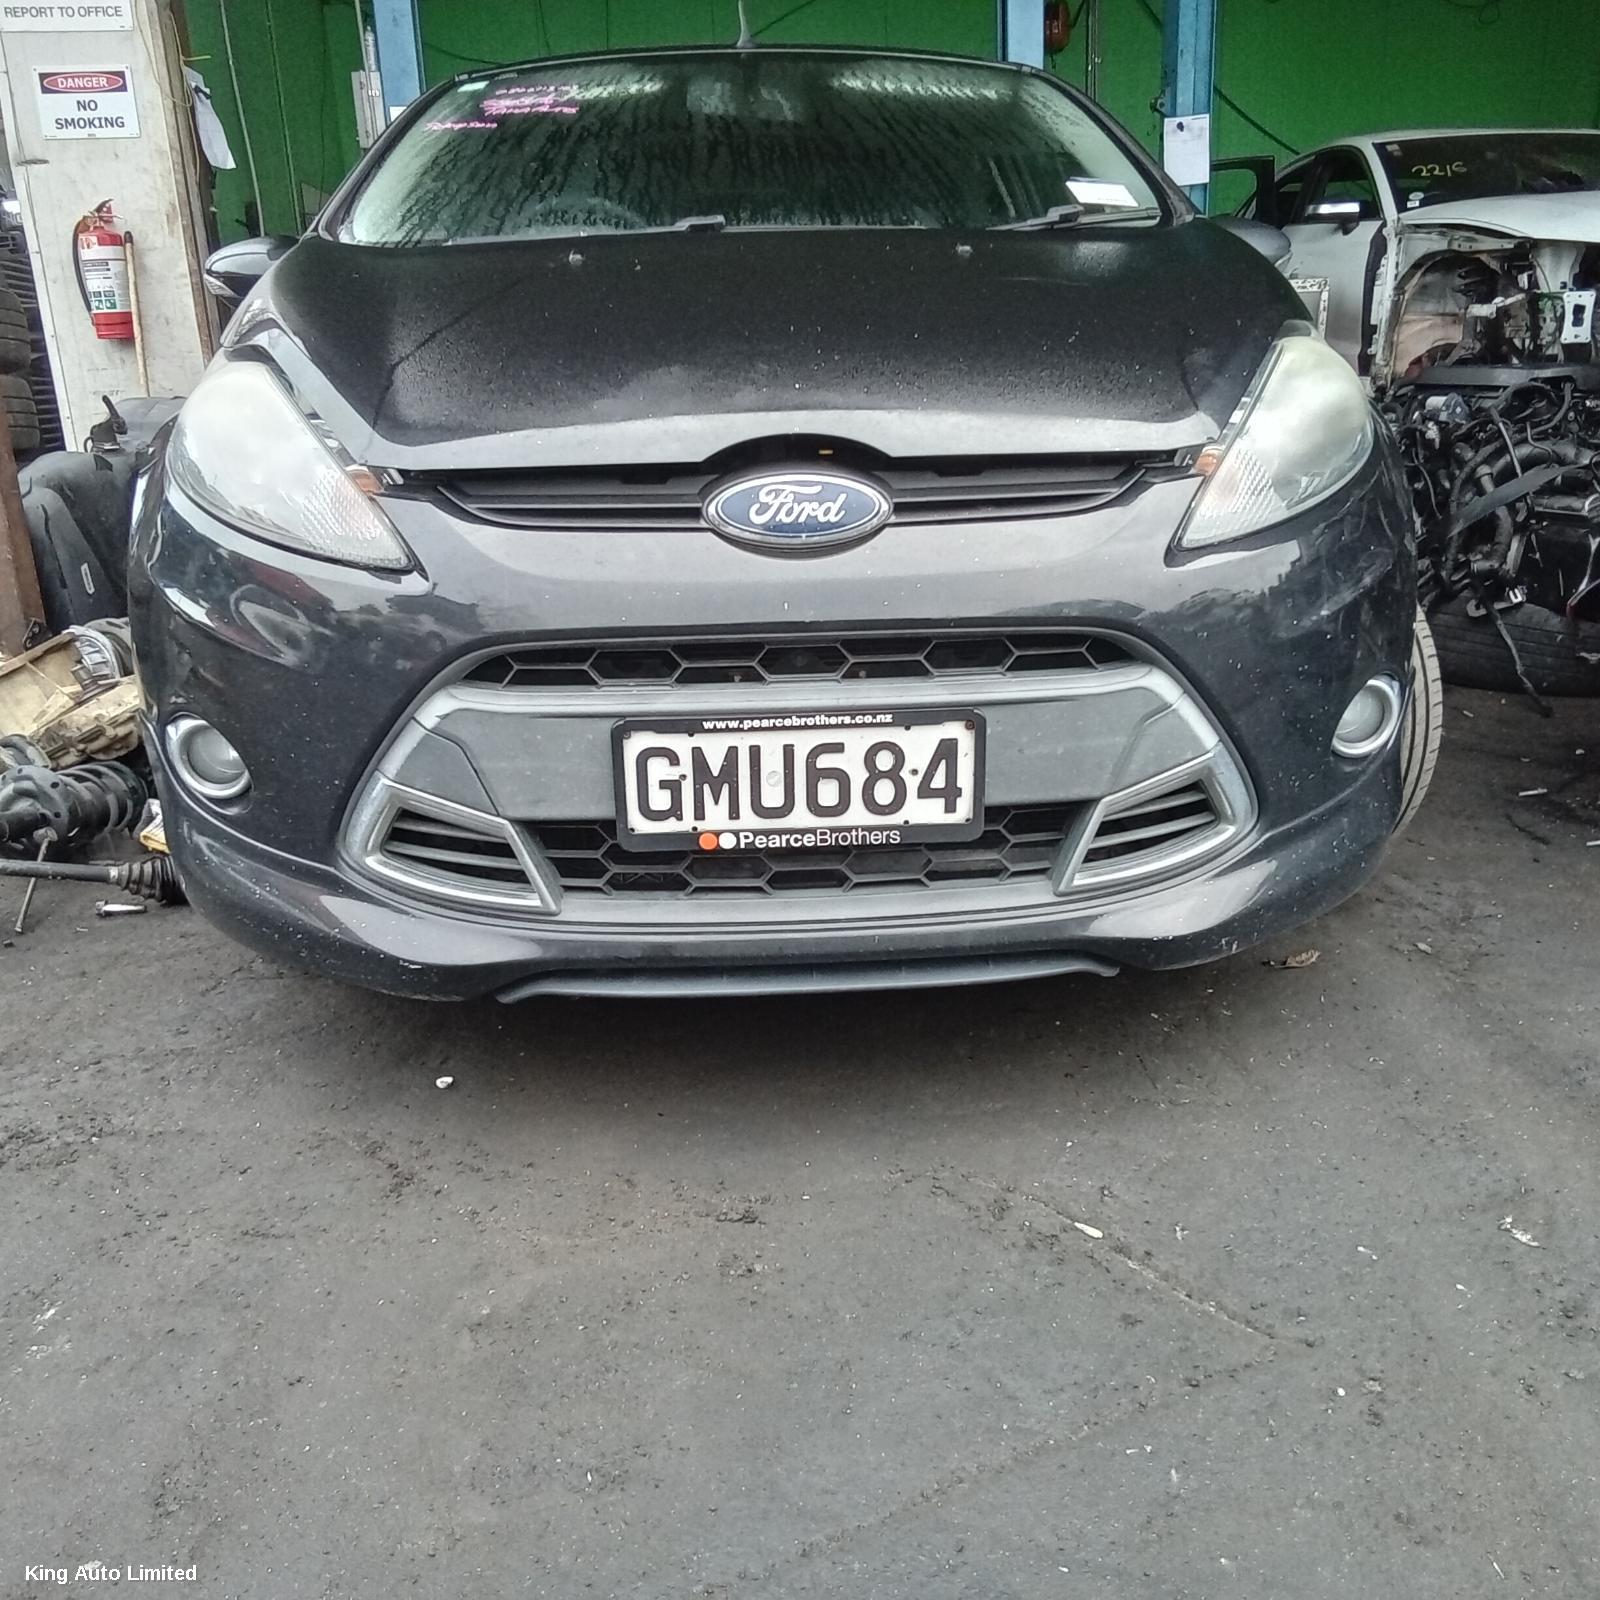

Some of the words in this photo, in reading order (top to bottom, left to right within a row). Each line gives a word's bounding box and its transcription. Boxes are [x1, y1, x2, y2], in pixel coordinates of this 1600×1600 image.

[4, 6, 54, 18] REPORT
[58, 6, 75, 18] TO
[78, 5, 123, 17] OFFICE
[57, 76, 109, 89] DANGER
[76, 99, 98, 112] NO
[55, 116, 125, 130] SMOKING
[749, 484, 847, 525] Ford
[702, 713, 893, 730] www.pearcebrothers.co.nz
[635, 738, 962, 822] GMU684
[739, 829, 901, 849] PearceBrothers
